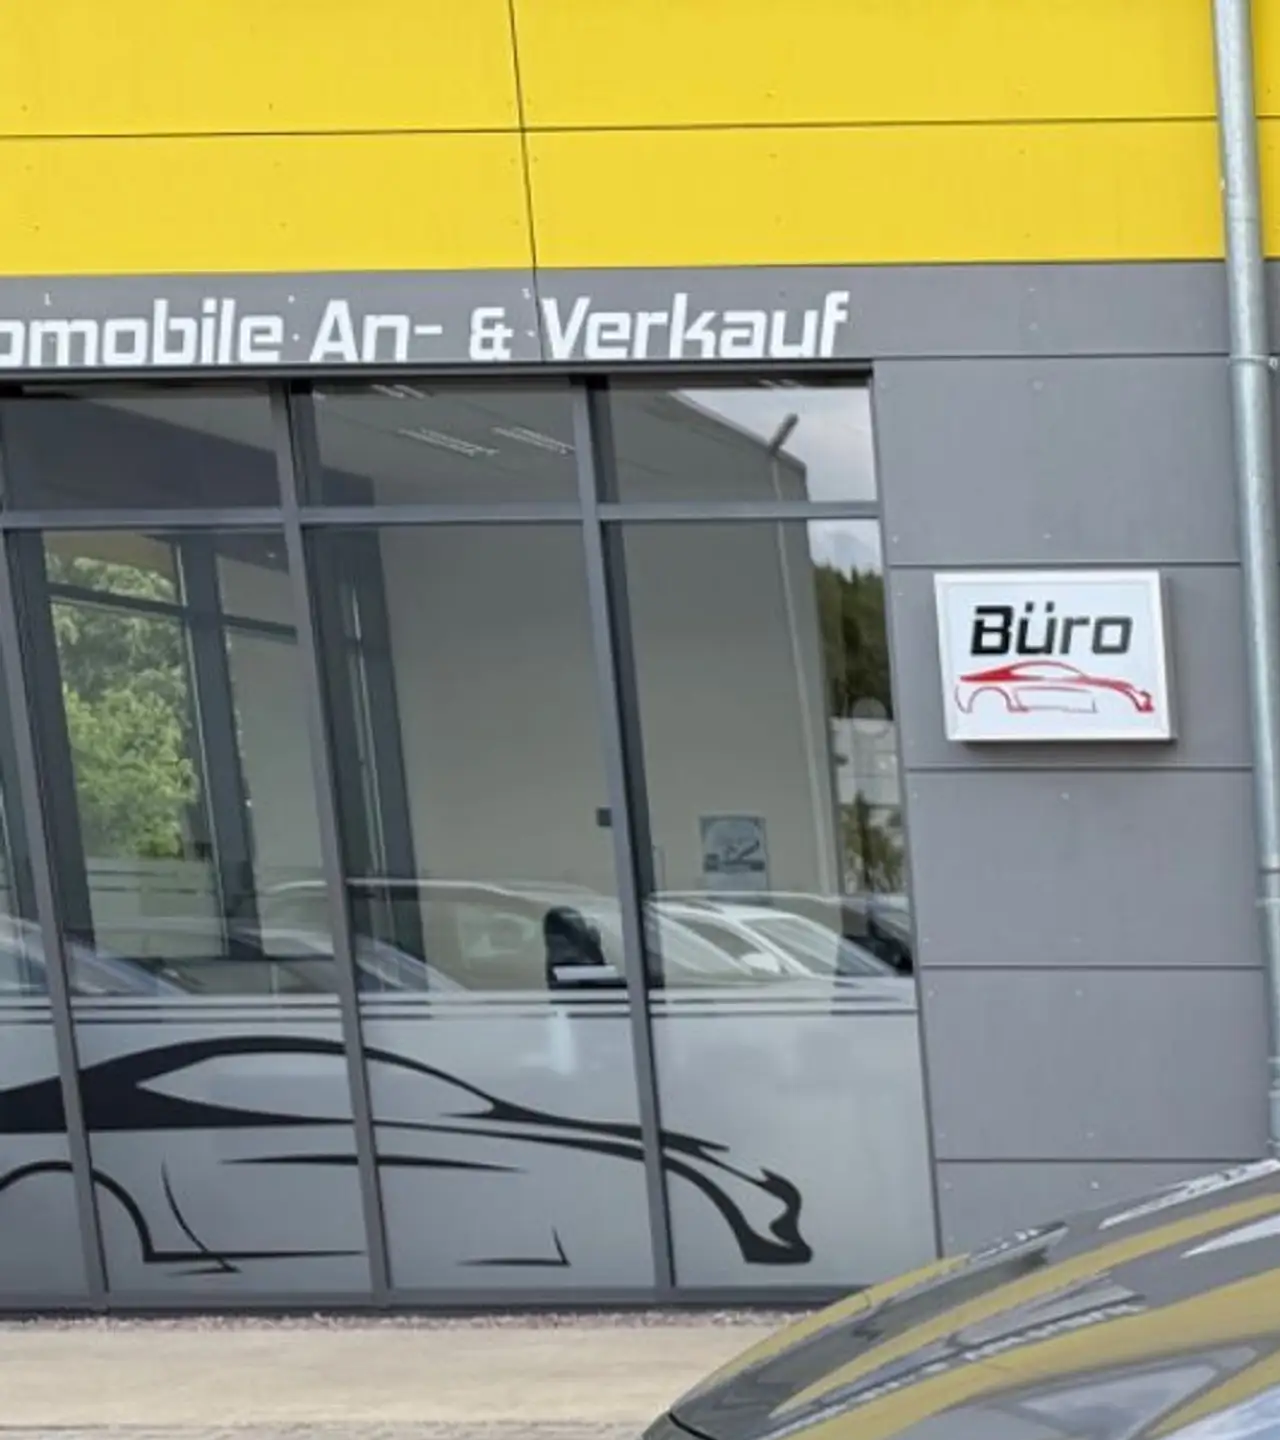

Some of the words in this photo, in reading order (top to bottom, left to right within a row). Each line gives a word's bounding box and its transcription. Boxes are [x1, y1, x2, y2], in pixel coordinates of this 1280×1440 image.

[309, 299, 443, 363] An-
[469, 306, 514, 360] &
[541, 291, 849, 358] Verkauf
[970, 601, 1133, 656] Büro
